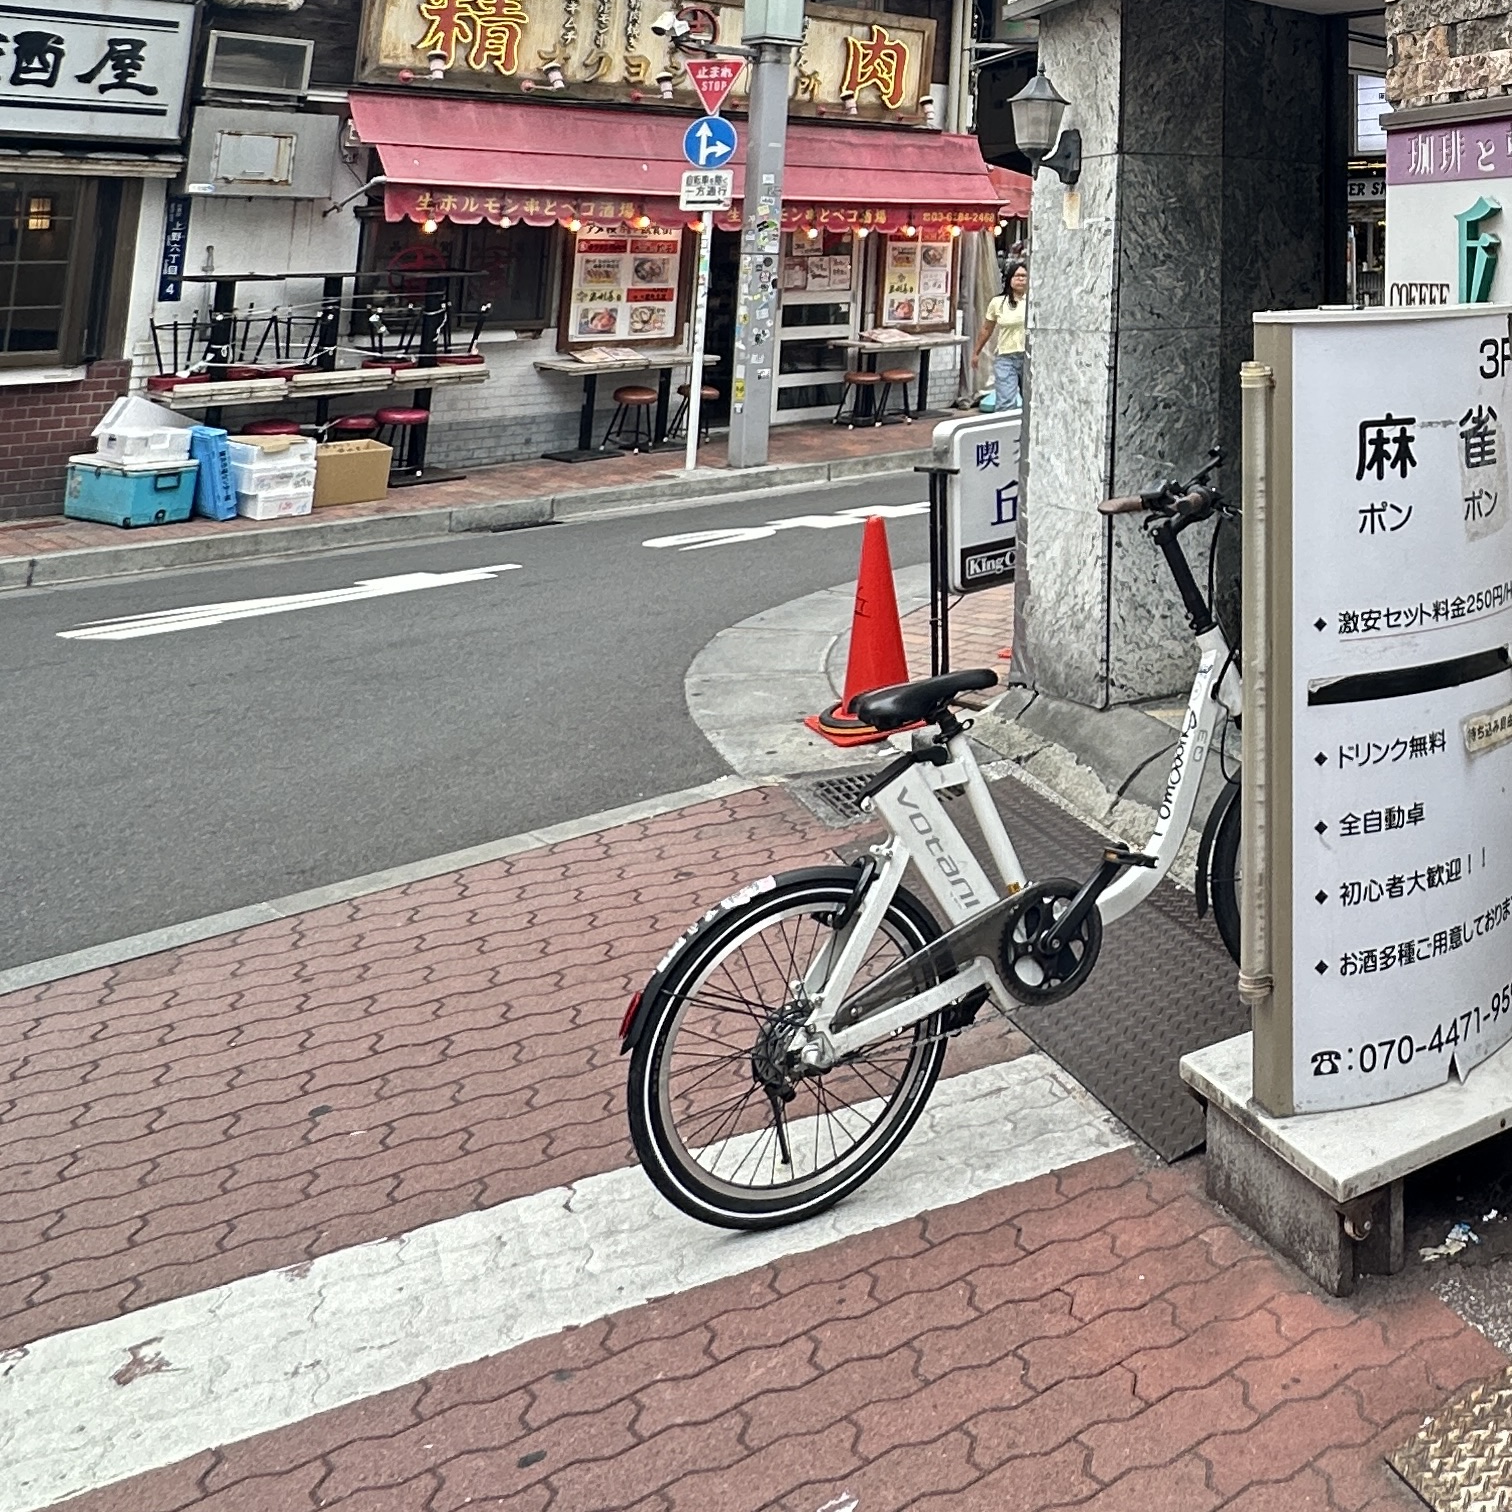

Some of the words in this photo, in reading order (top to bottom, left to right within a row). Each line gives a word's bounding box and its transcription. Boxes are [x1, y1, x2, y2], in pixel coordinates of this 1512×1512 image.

[0, 28, 158, 96] 酒屋
[697, 66, 733, 79] 止まれ
[701, 81, 727, 92] STOP
[685, 175, 728, 186] 自転車を除く
[685, 187, 728, 197] 一方通行
[165, 283, 175, 295] 4
[1359, 501, 1413, 534] ポン
[1464, 488, 1498, 522] ポン
[1338, 580, 1512, 635] 激安セット料金250円/H
[1339, 729, 1446, 769] ドリンク無料
[1339, 802, 1425, 838] 全自動卓
